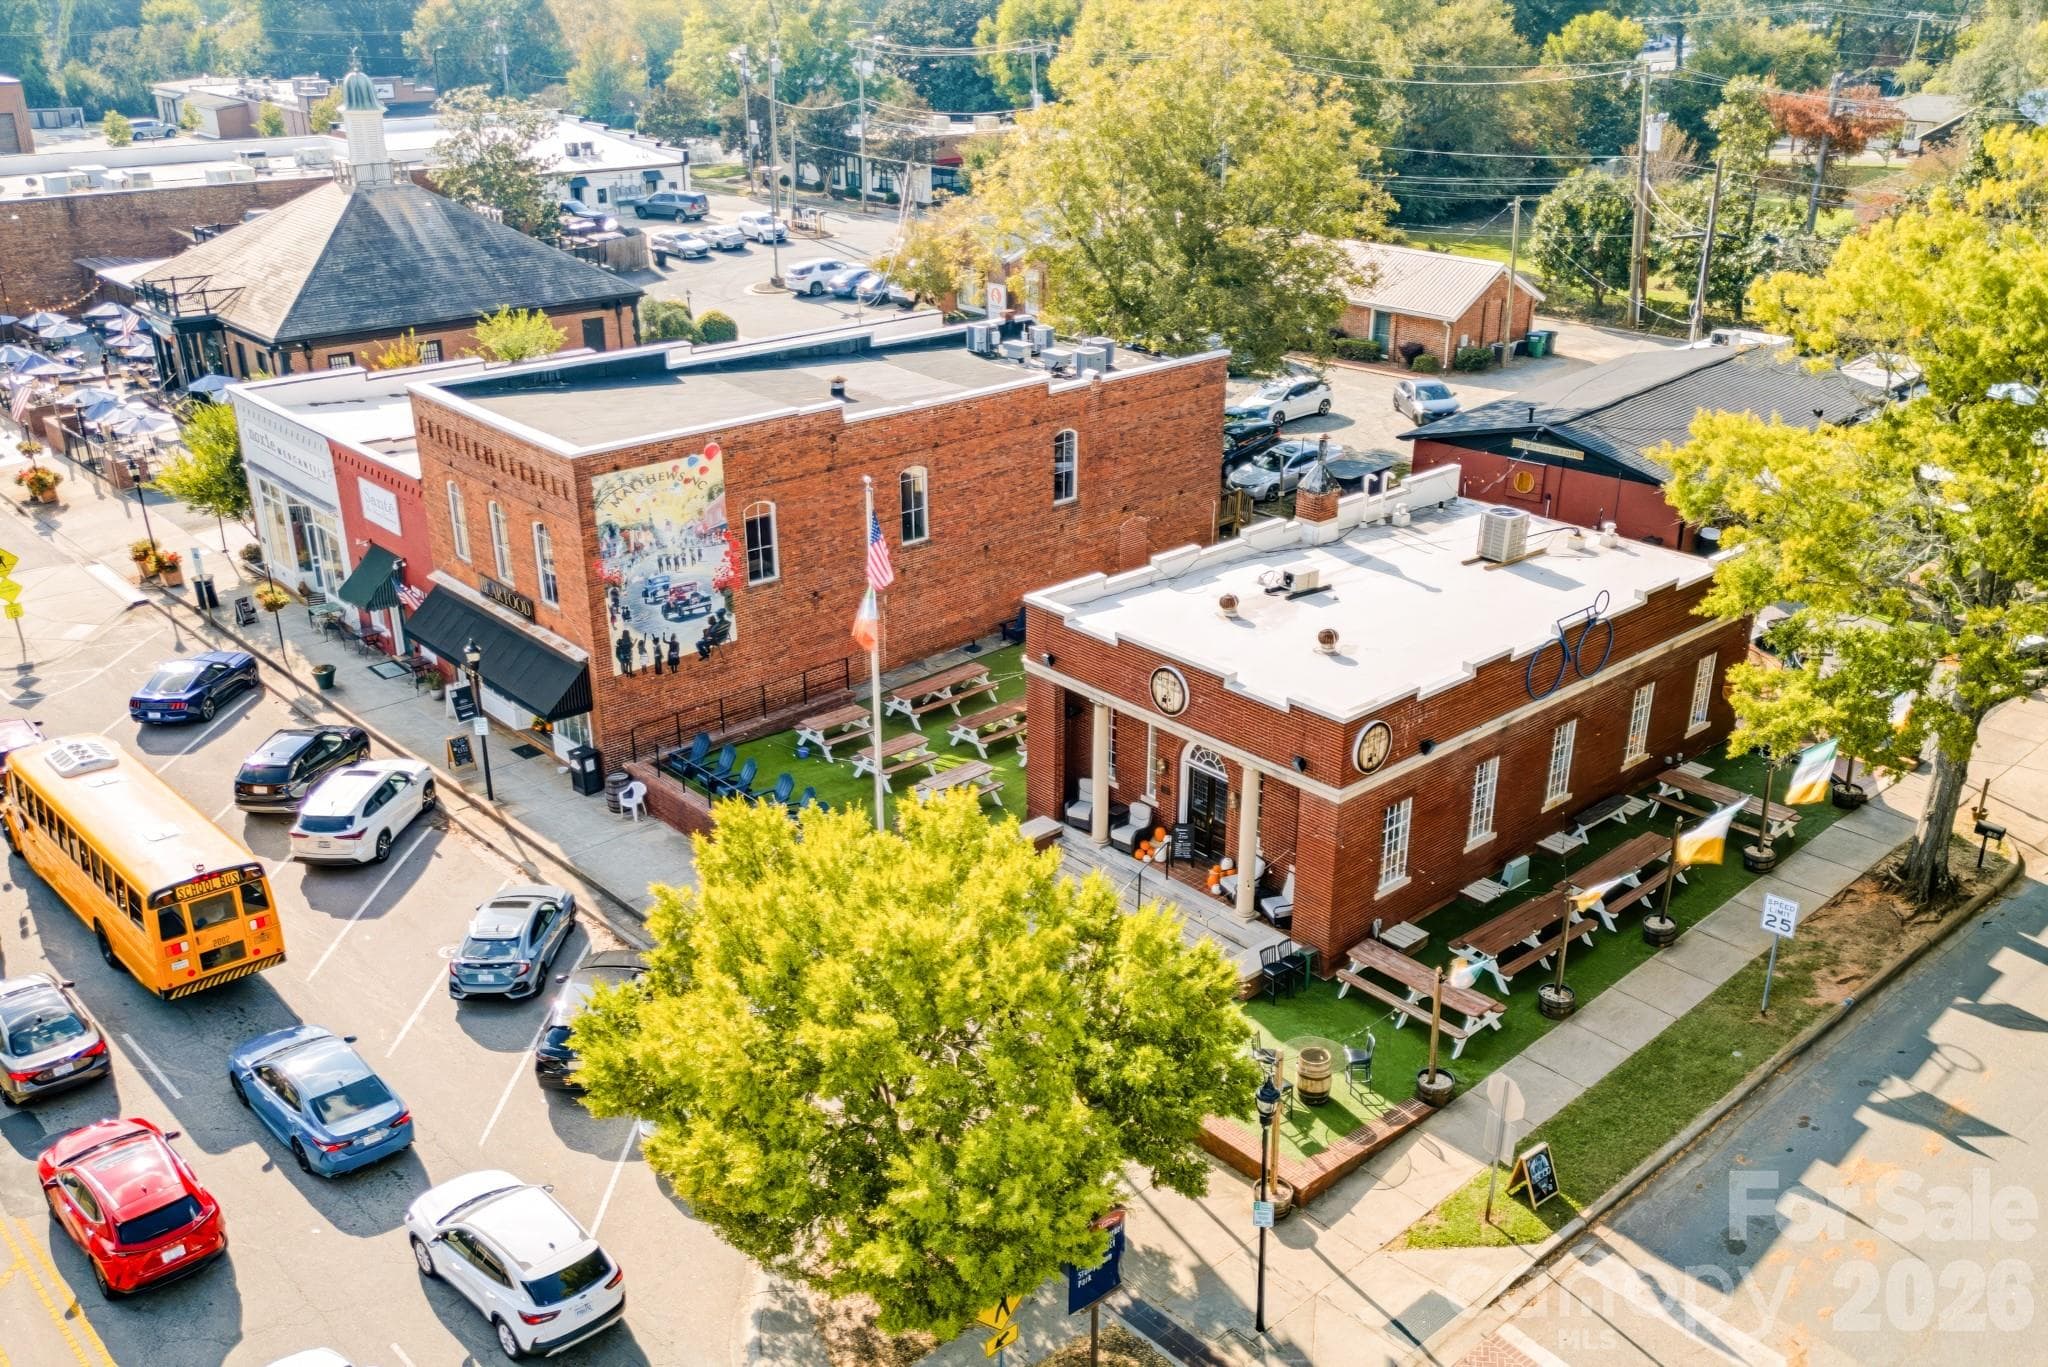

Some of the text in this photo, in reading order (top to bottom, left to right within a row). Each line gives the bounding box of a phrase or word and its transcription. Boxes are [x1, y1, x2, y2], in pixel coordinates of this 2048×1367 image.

[177, 872, 240, 899] SCHOOL BUS
[1767, 898, 1795, 912] SPEED
[1764, 913, 1791, 932] 25
